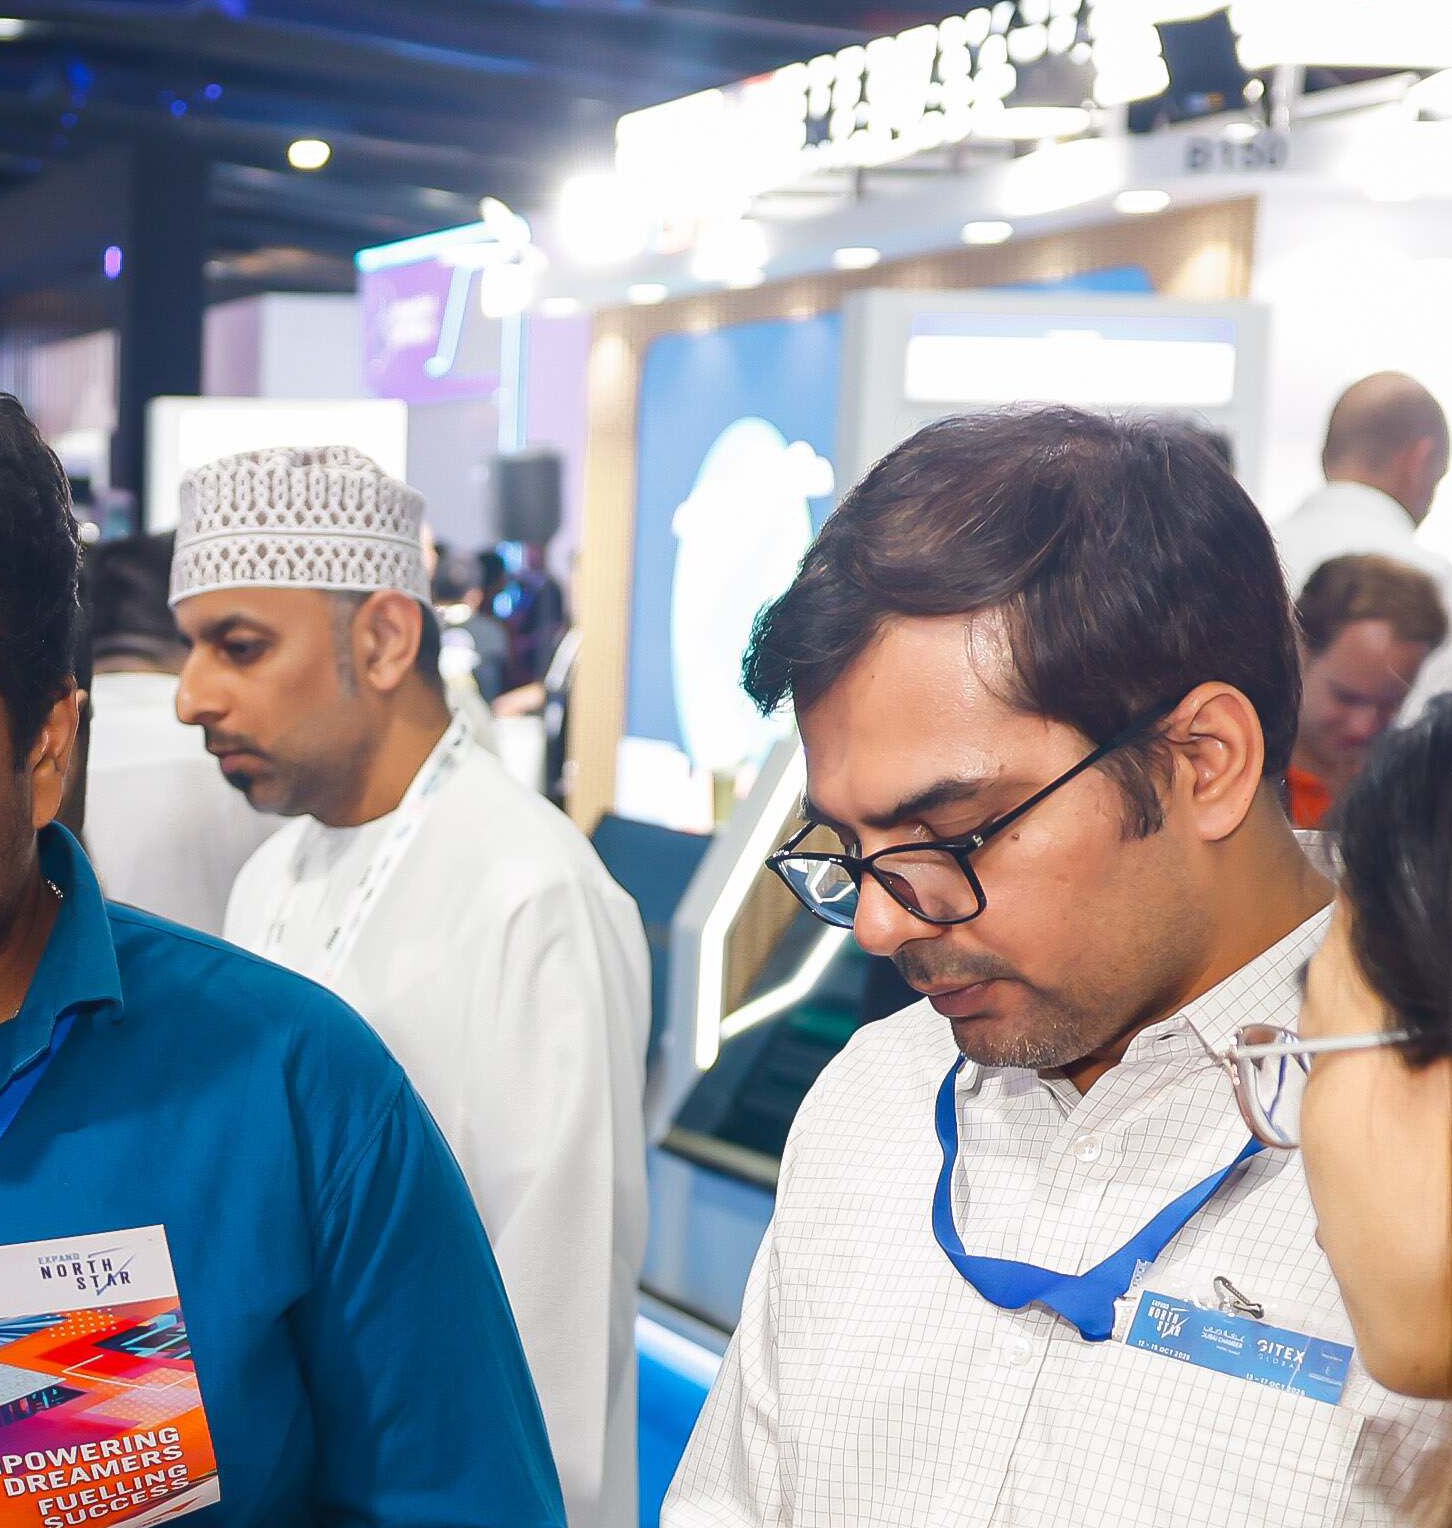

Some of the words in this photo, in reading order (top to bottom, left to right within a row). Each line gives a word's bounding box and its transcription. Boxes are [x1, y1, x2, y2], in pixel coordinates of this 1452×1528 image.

[37, 1252, 80, 1266] EXPAND
[40, 1258, 114, 1281] NORTH
[76, 1270, 132, 1292] STAR
[1147, 1306, 1180, 1325] NORTH
[1256, 1339, 1306, 1365] GITEX
[3, 1444, 184, 1498] DREAMERS
[37, 1464, 189, 1516] FUELLING
